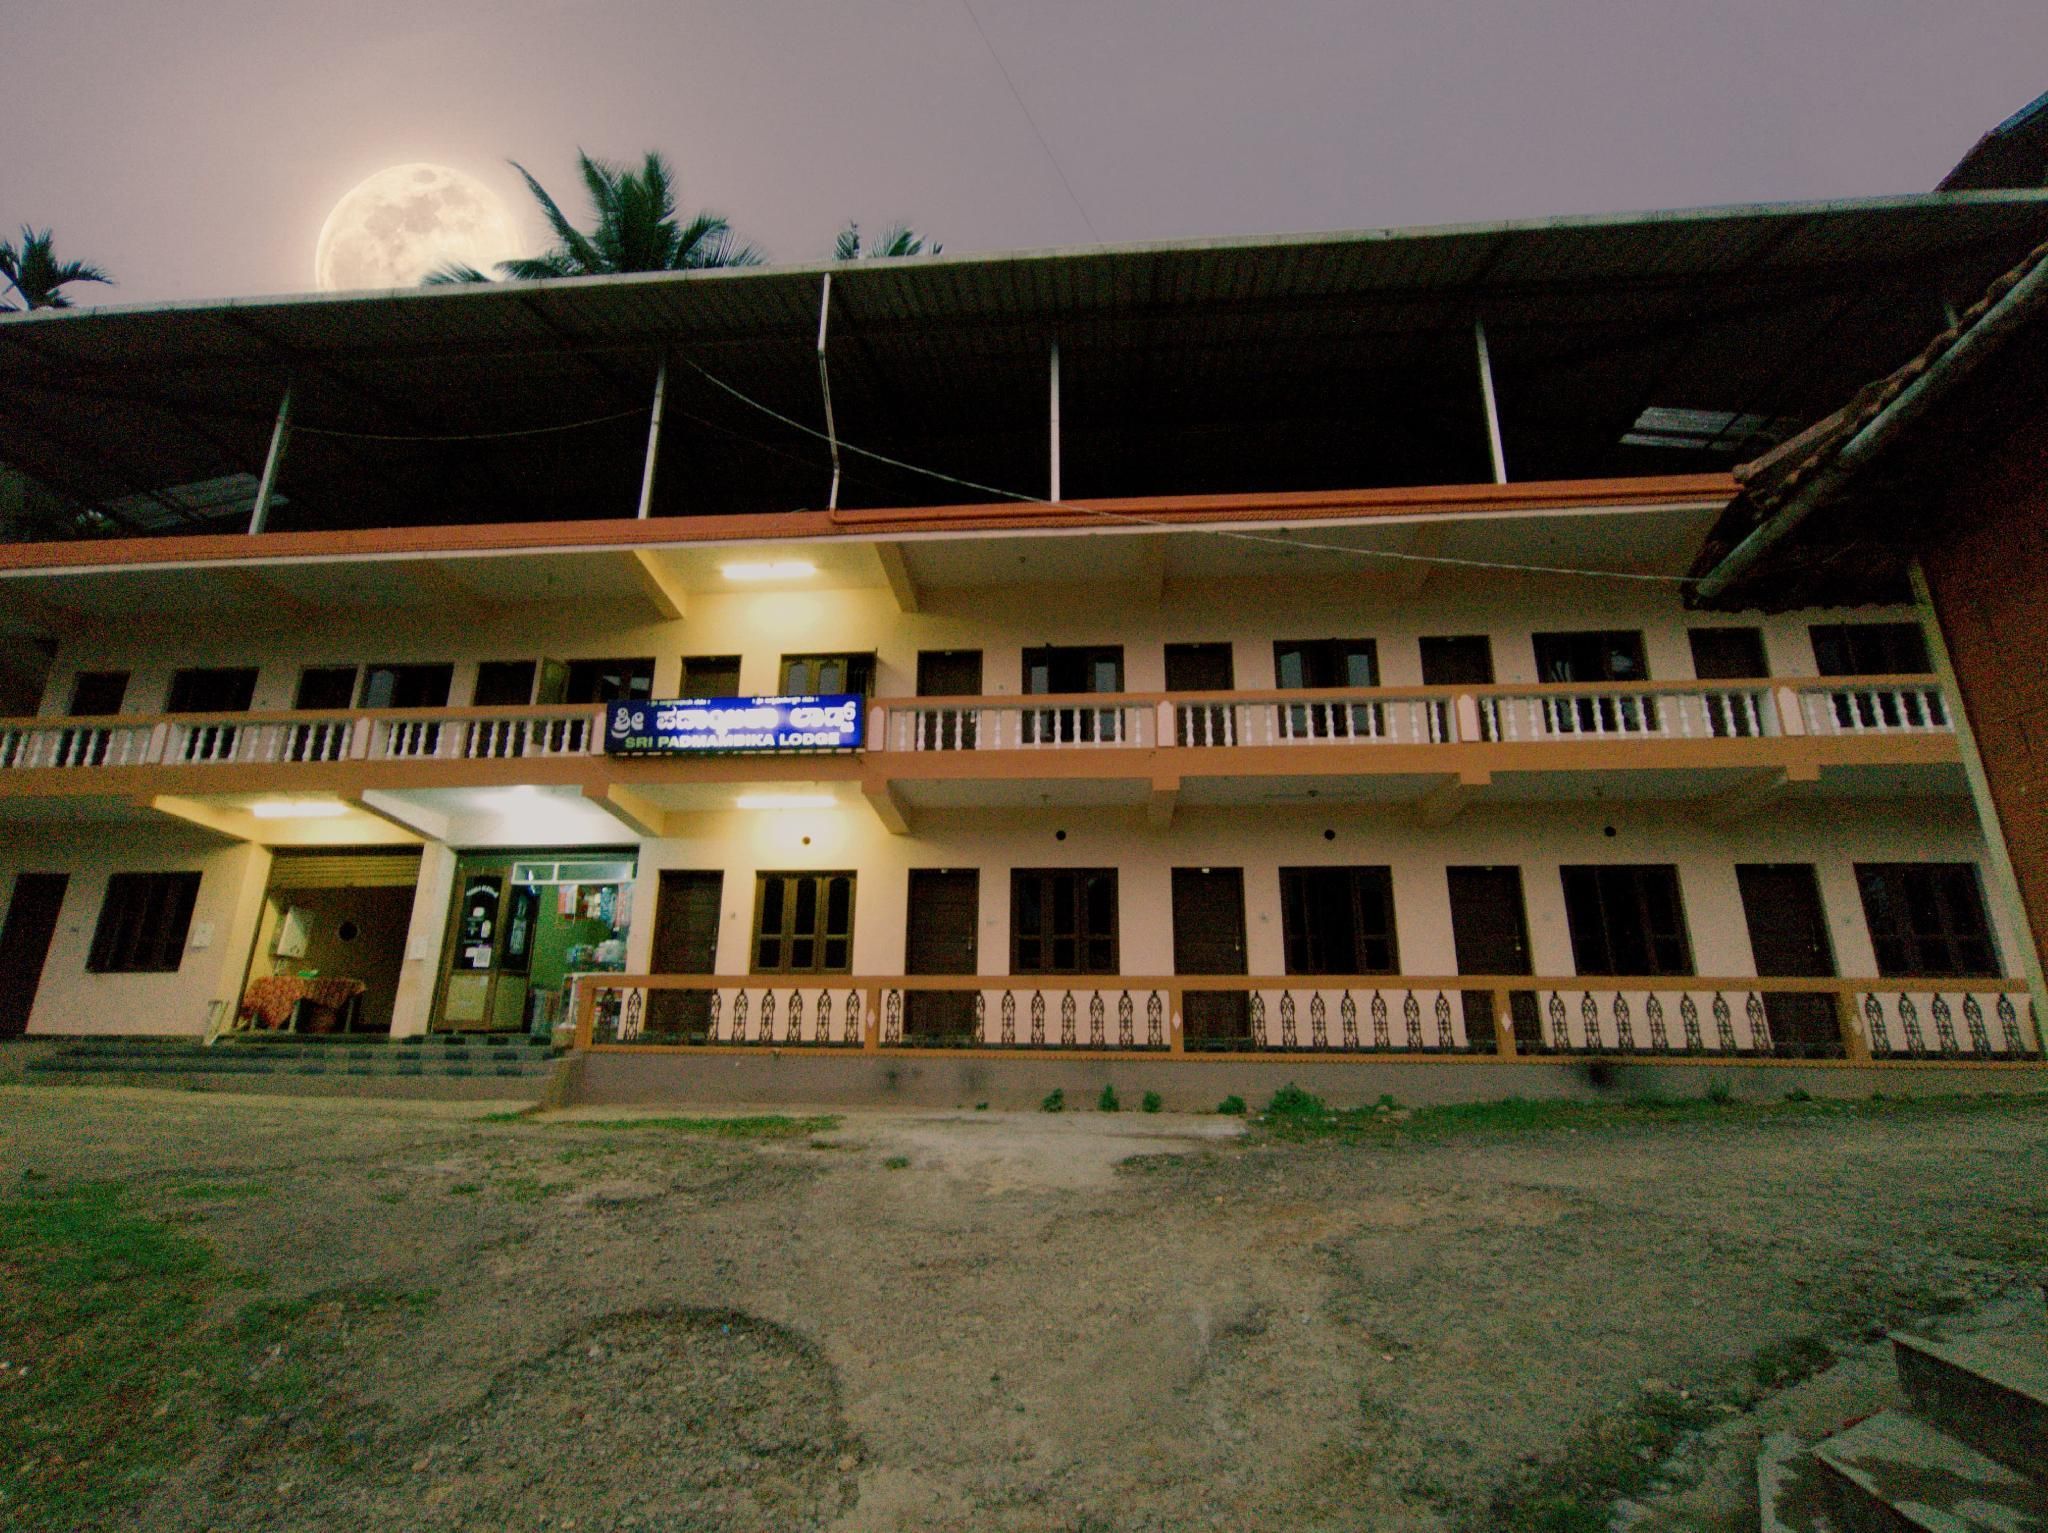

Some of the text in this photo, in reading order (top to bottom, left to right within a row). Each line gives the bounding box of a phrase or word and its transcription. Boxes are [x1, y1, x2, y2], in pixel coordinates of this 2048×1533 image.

[610, 707, 645, 739] ಶ್ರೀ
[624, 731, 841, 749] SRI PADMAMBIKA LODGE
